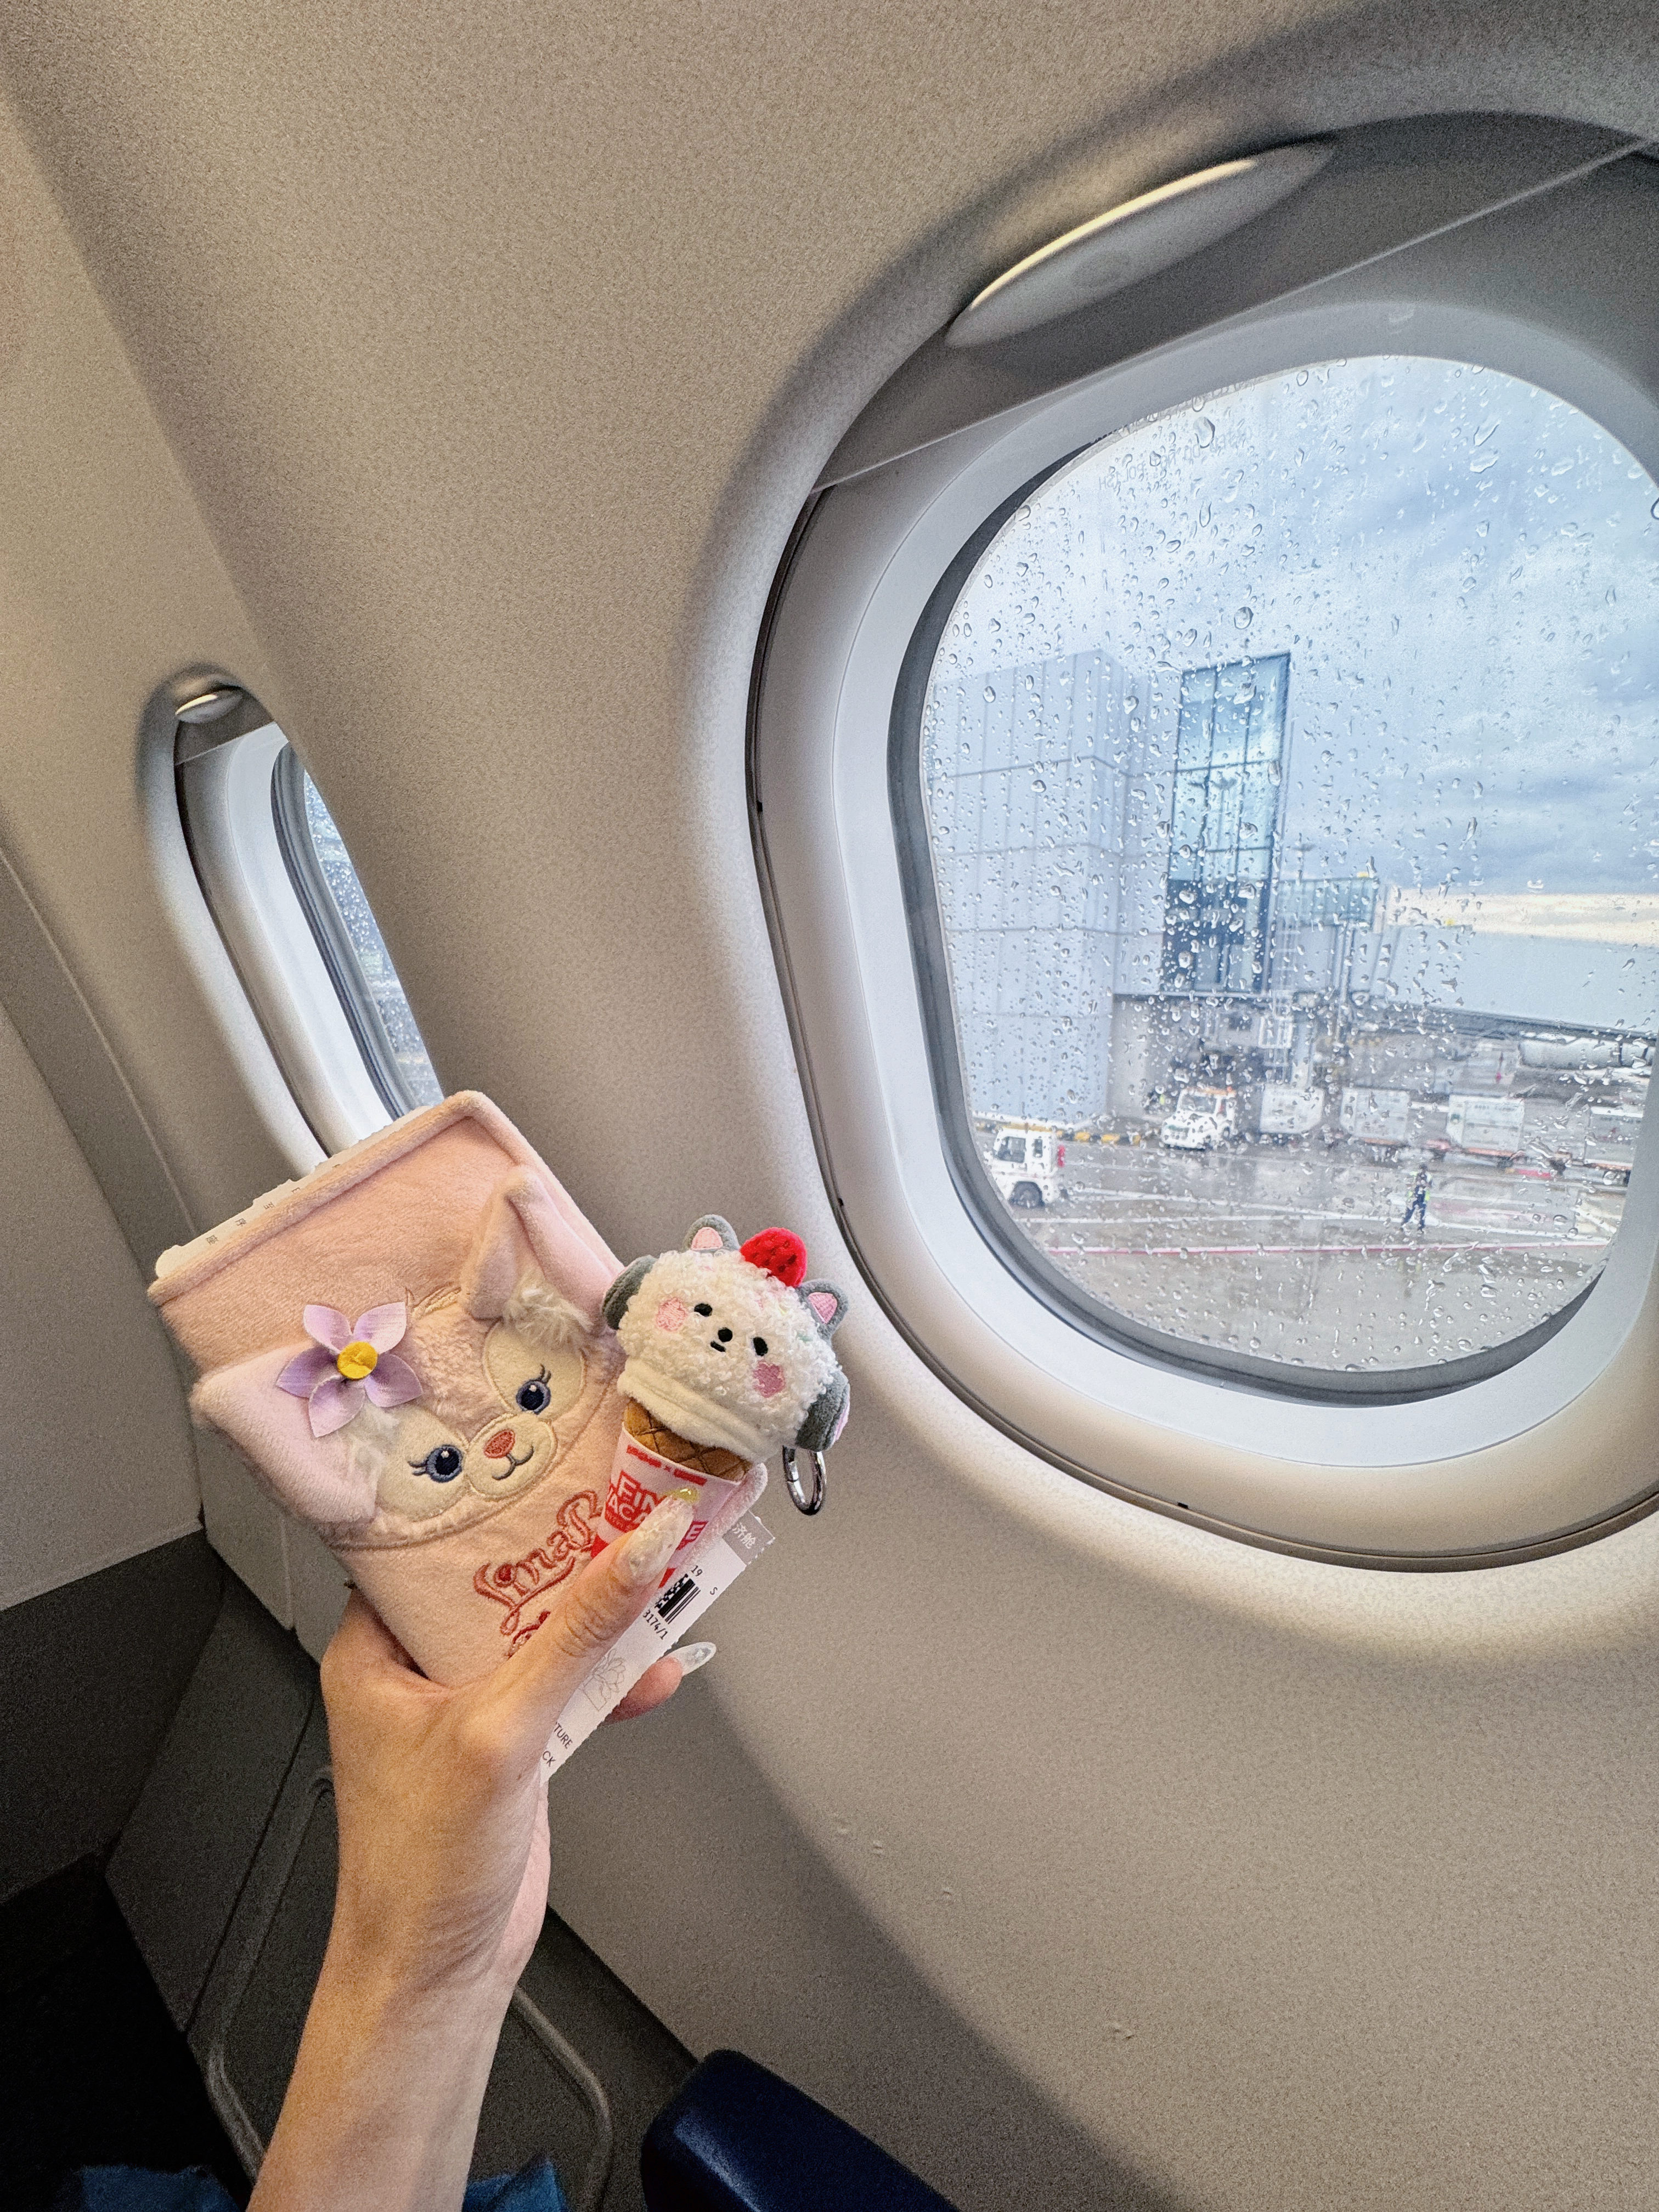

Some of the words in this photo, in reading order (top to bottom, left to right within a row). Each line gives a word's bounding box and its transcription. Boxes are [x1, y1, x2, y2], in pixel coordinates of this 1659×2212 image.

[691, 1565, 703, 1577] 19
[642, 1609, 668, 1640] 3174/1
[554, 1721, 573, 1749] TURE
